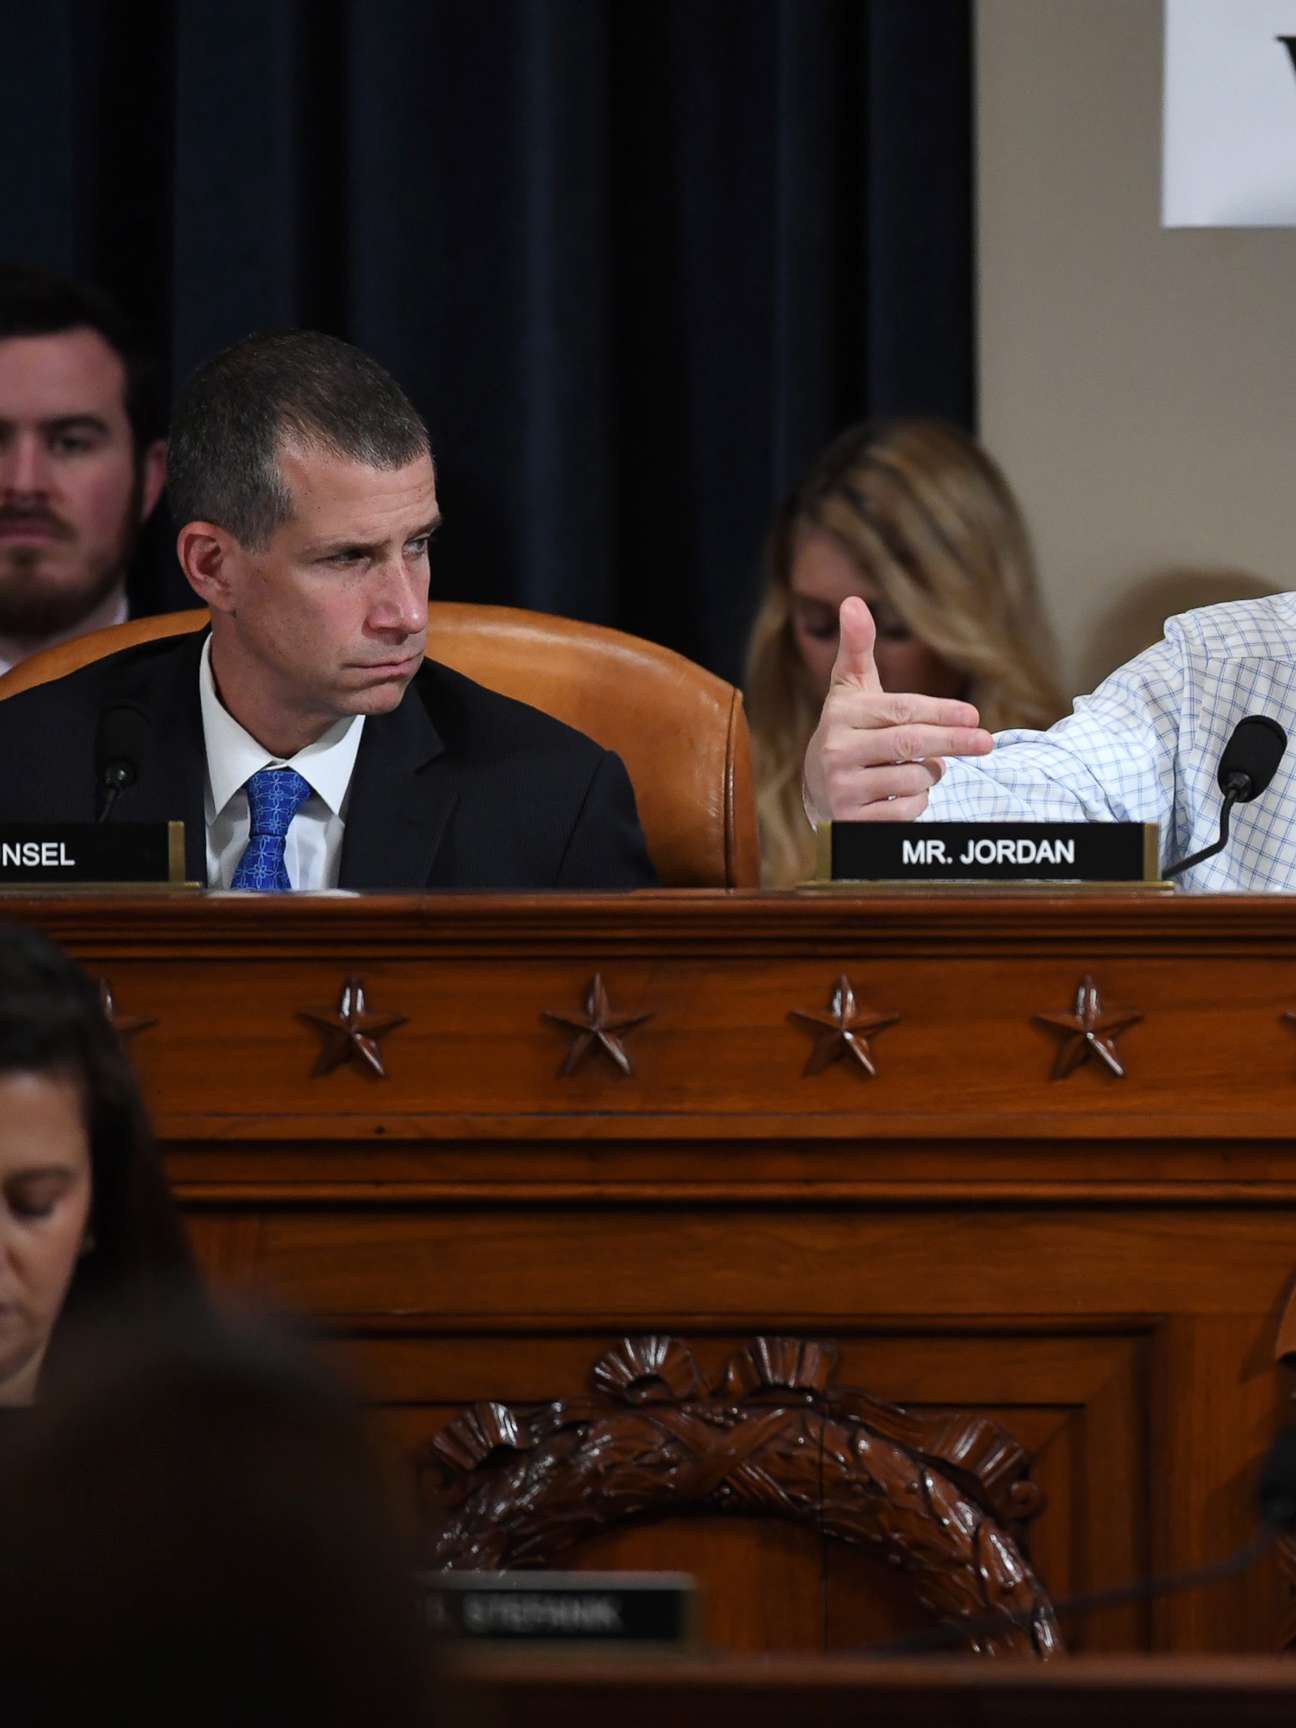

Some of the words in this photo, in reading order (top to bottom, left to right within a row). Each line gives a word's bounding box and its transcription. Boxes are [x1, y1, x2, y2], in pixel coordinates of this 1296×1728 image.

[0, 842, 76, 866] NSEL
[902, 839, 953, 865] MR.
[959, 839, 1075, 865] JORDAN
